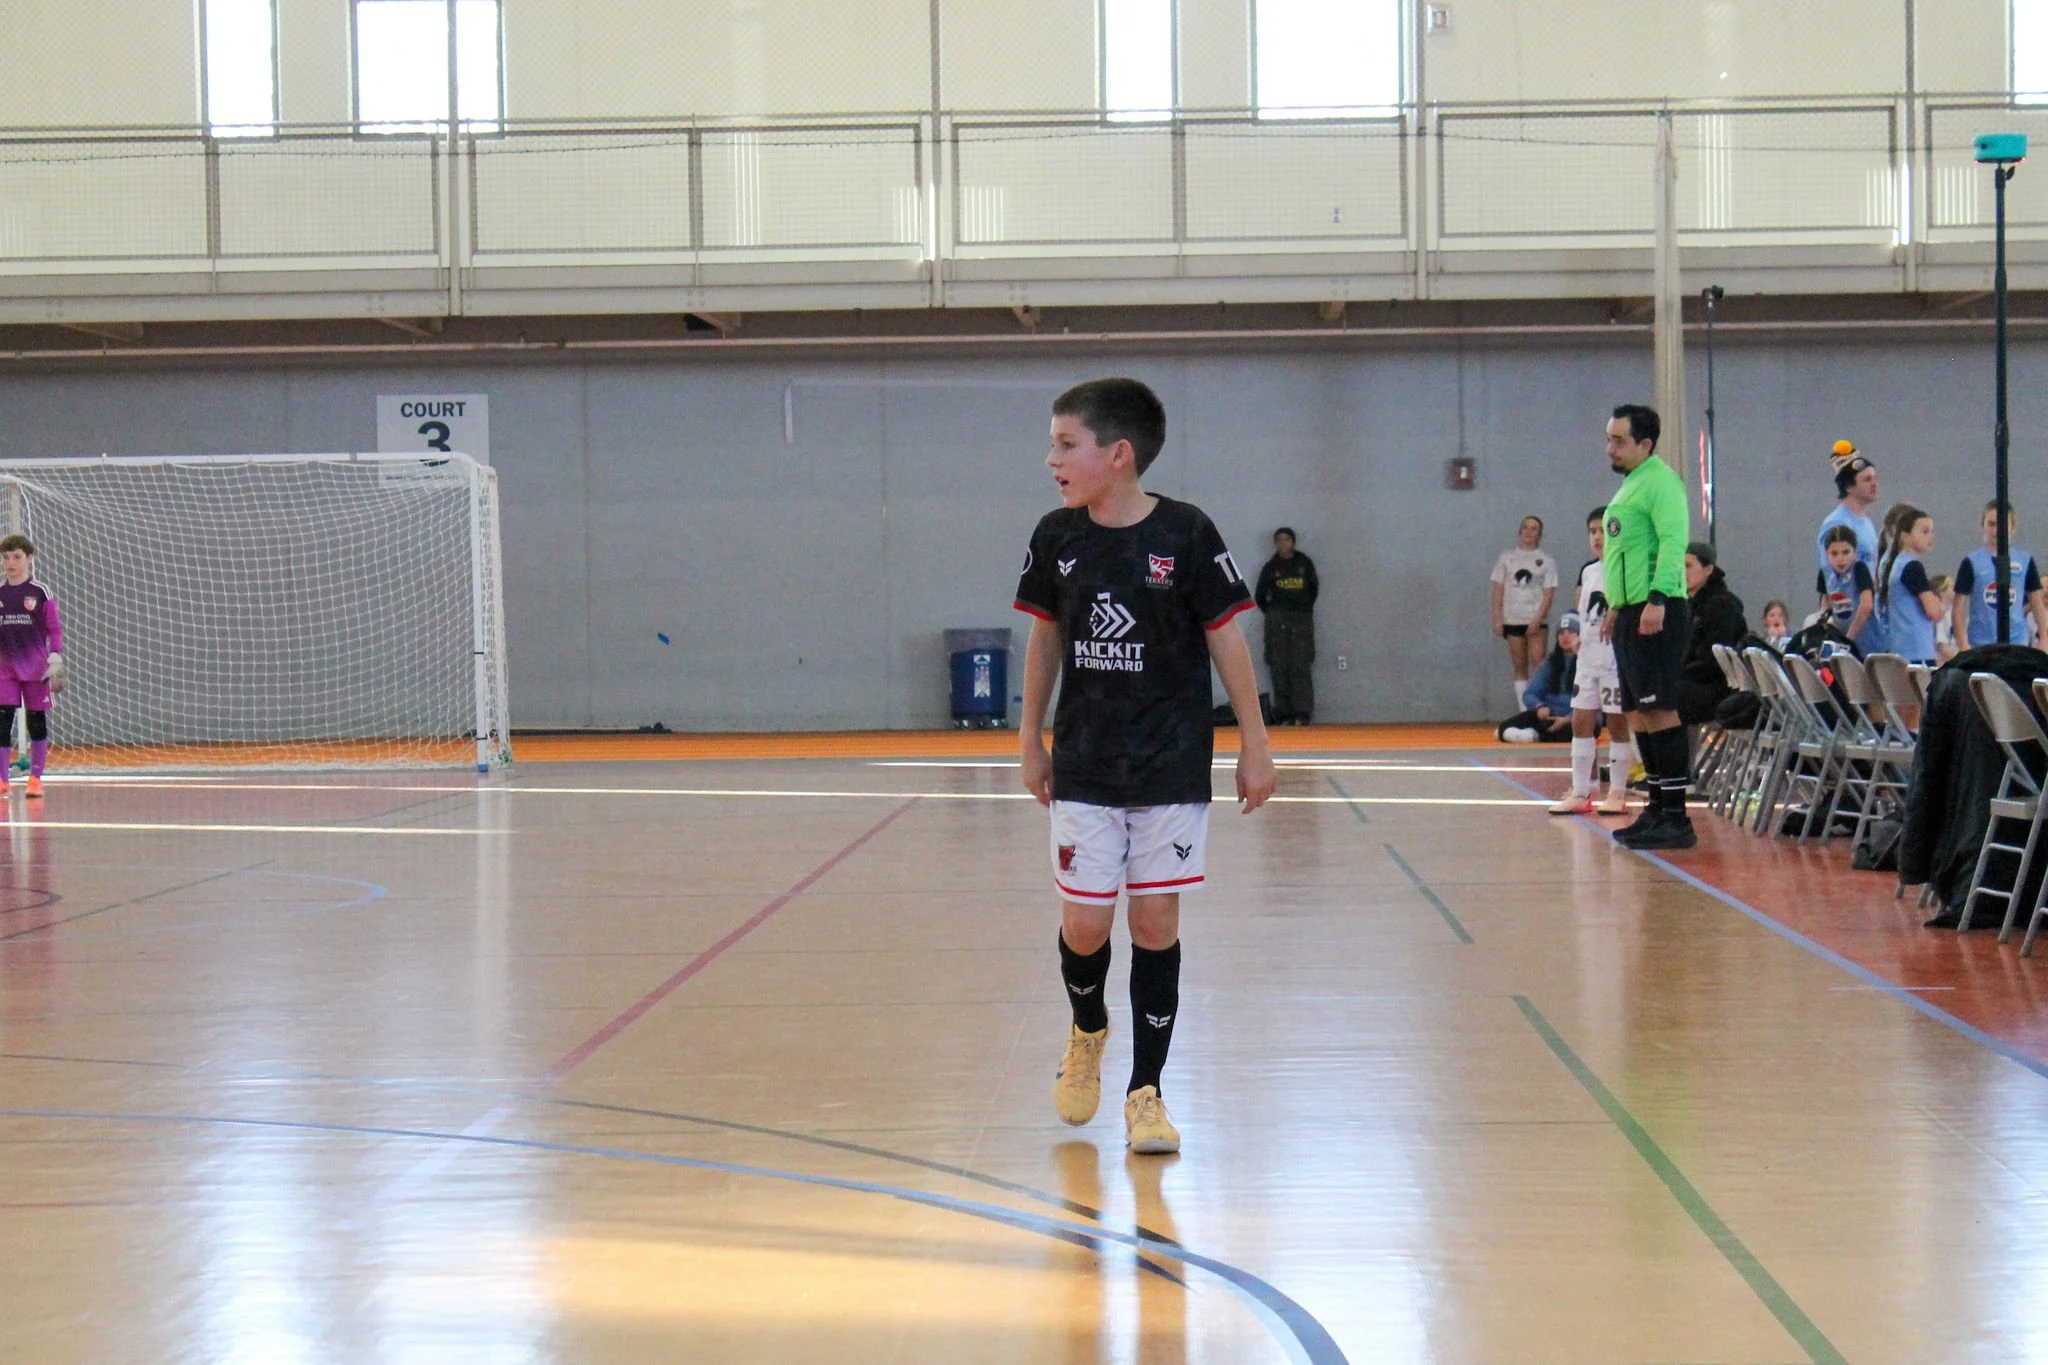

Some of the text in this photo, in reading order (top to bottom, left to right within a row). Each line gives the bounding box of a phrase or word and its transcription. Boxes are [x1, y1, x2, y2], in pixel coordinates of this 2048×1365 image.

[401, 401, 466, 418] COURT
[417, 421, 452, 467] 3
[1075, 657, 1144, 672] FORWARD
